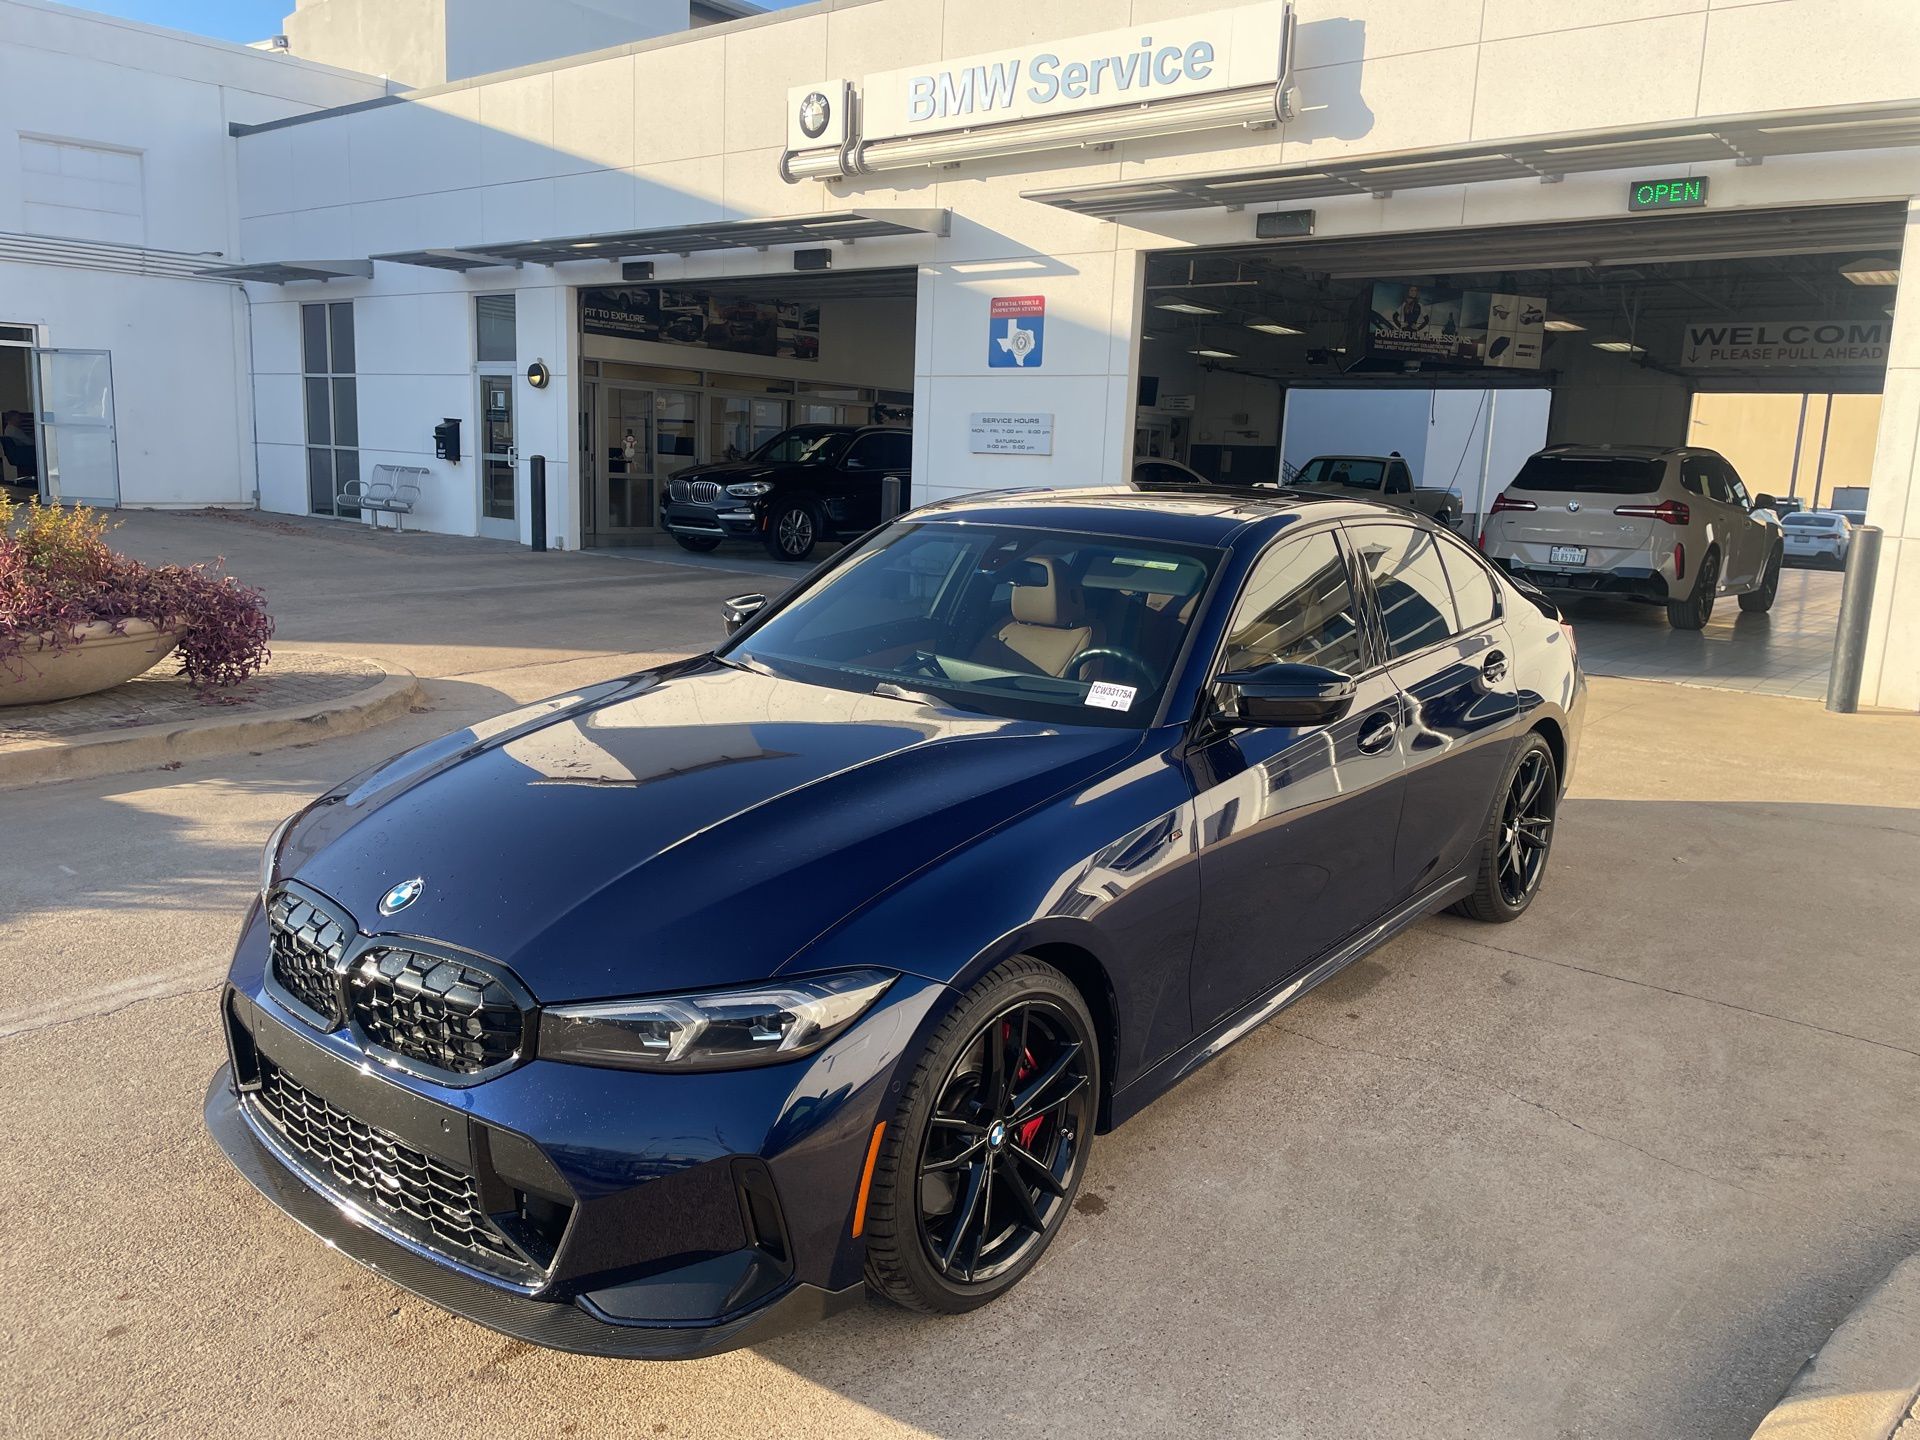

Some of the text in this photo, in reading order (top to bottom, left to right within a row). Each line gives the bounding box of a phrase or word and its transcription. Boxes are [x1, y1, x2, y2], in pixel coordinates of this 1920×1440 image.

[907, 36, 1214, 122] BMW Service
[1636, 181, 1700, 204] OPEN
[584, 307, 597, 317] FIT
[598, 309, 610, 319] TO
[1375, 329, 1418, 340] POWERFUL
[1710, 347, 1883, 360] PLEASE PULL AHEAD
[1092, 685, 1133, 699] TCW33175A
